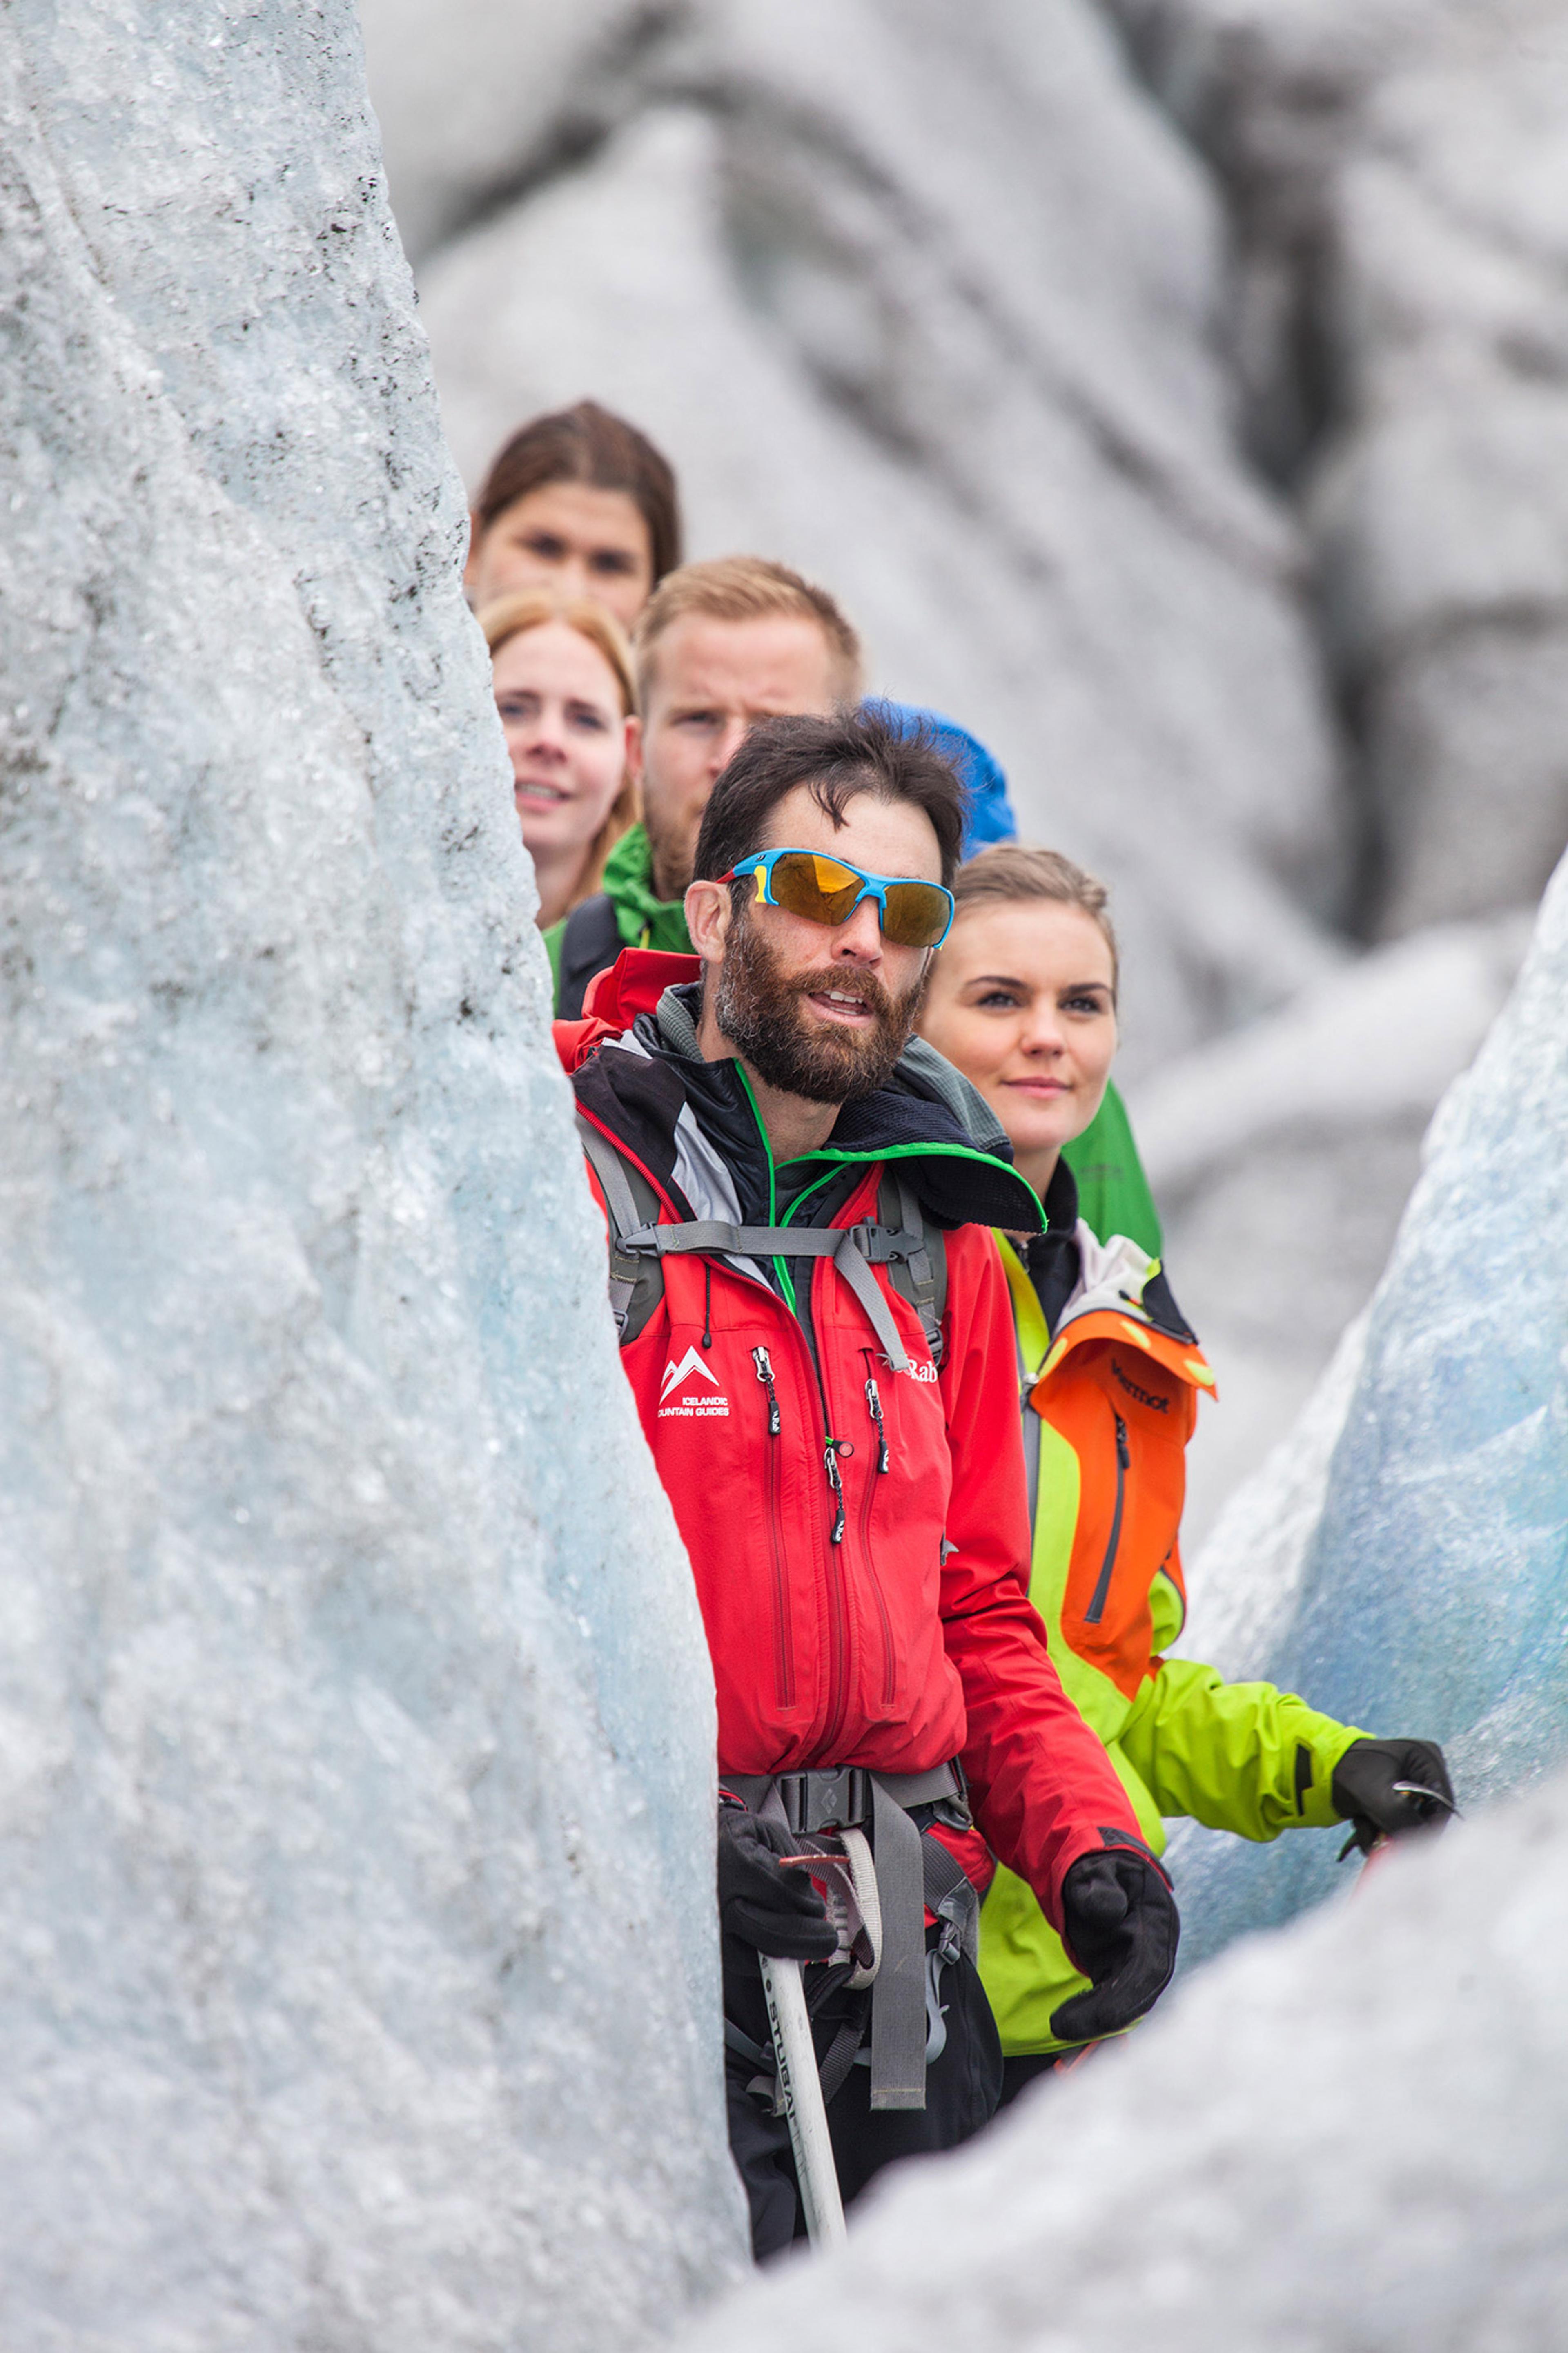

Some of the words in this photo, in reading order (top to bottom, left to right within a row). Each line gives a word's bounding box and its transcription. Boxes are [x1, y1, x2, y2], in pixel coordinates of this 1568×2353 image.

[907, 1359, 938, 1383] Rab
[682, 1397, 728, 1406] ICELANDIC
[657, 1407, 693, 1418] OUNTAIN
[695, 1407, 729, 1416] GUIDES
[769, 2001, 796, 2119] STUBAI
